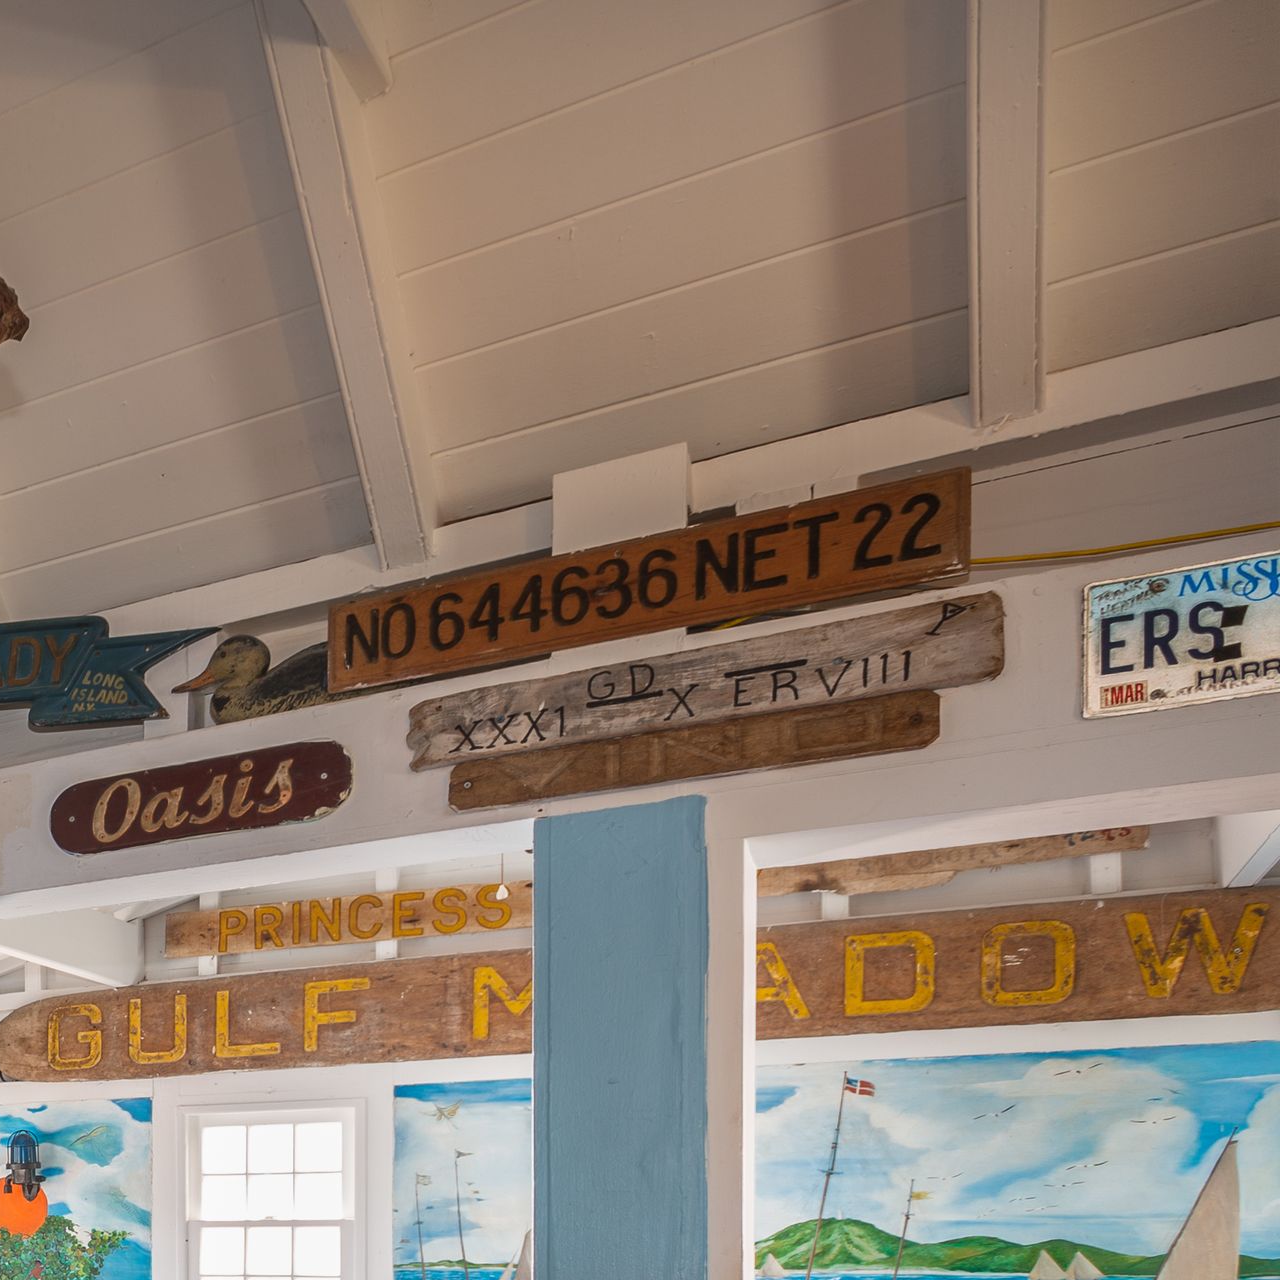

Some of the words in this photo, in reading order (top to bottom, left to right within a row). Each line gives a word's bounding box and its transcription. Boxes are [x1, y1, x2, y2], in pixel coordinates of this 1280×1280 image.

[428, 550, 678, 652] 644636
[694, 511, 839, 600] NET
[852, 493, 941, 571] 22
[70, 688, 128, 705] ISLAND
[81, 670, 125, 690] LONG
[1111, 683, 1144, 704] MAR
[92, 758, 294, 843] Oasis
[217, 884, 514, 953] PRINCESS
[47, 977, 371, 1071] GULF
